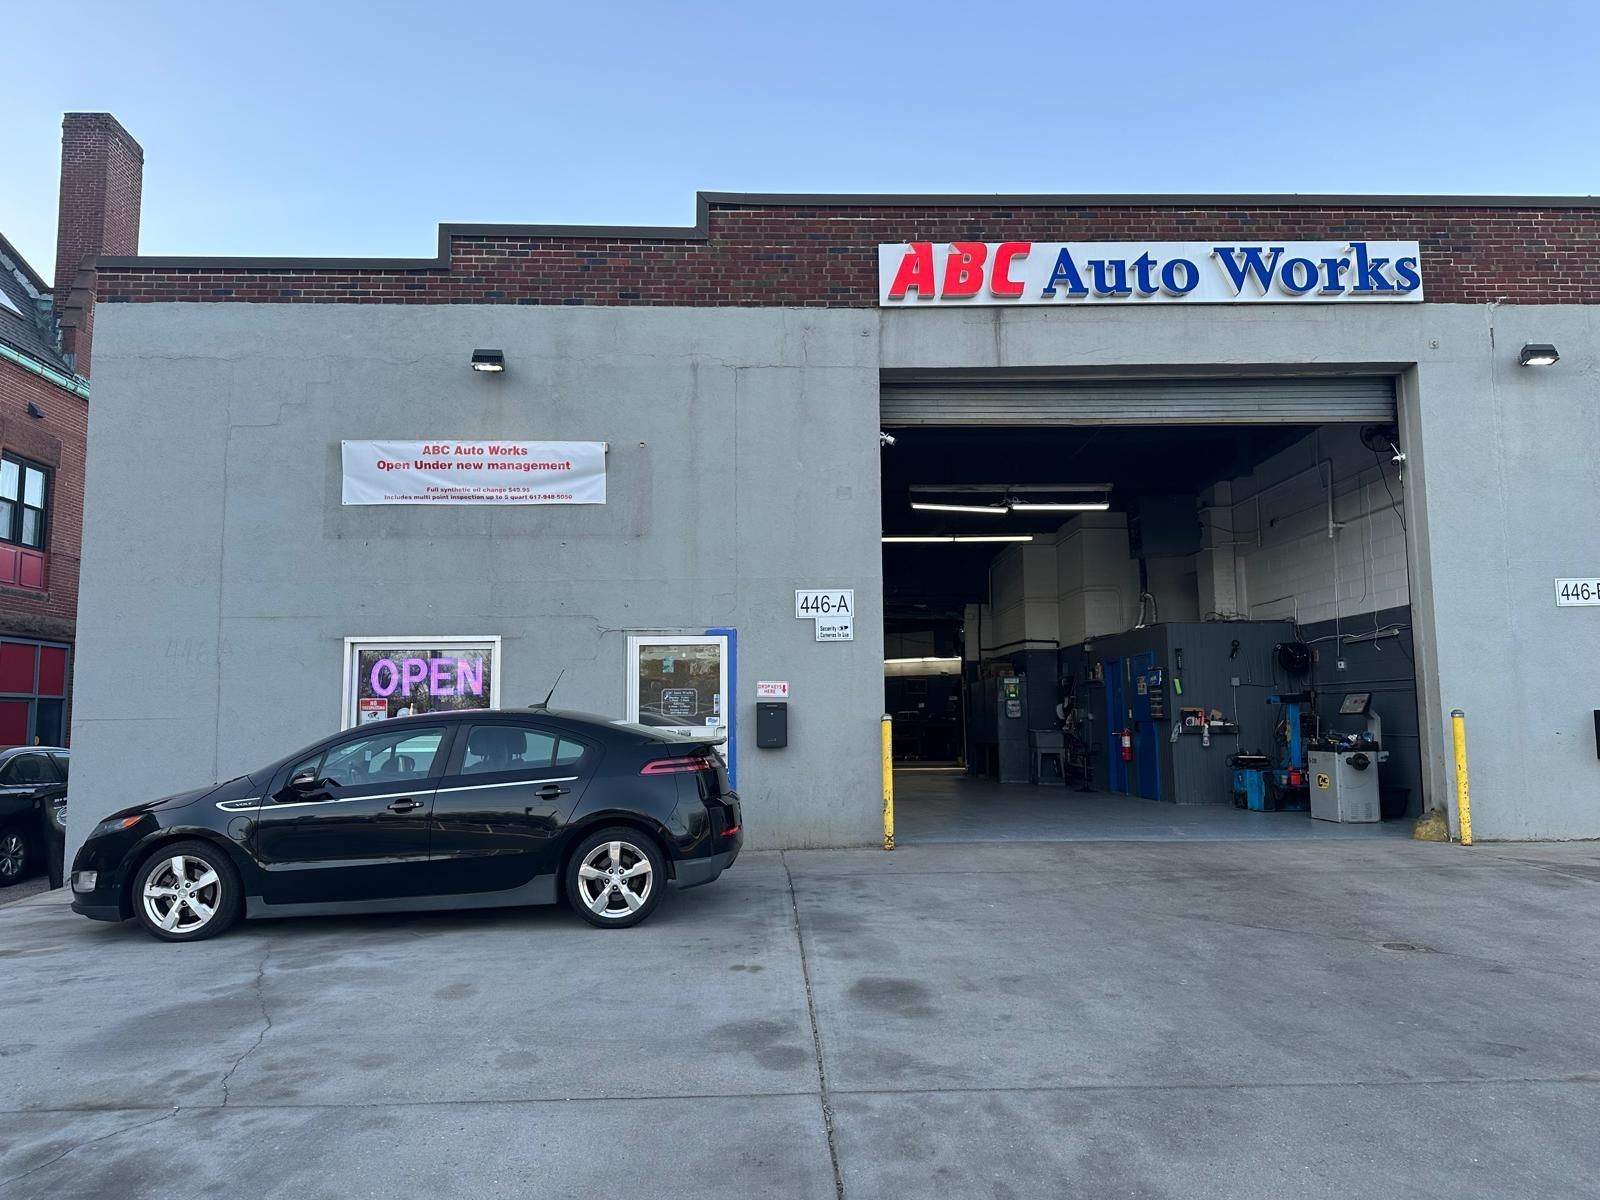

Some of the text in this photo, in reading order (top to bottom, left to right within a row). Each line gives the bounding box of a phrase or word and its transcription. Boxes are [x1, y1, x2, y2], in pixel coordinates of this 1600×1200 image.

[888, 241, 1421, 298] ABC Auto Works
[422, 445, 528, 455] ABC Auto Works
[377, 460, 571, 472] Open Under new management
[800, 595, 849, 613] 446-A
[371, 656, 483, 696] OPEN
